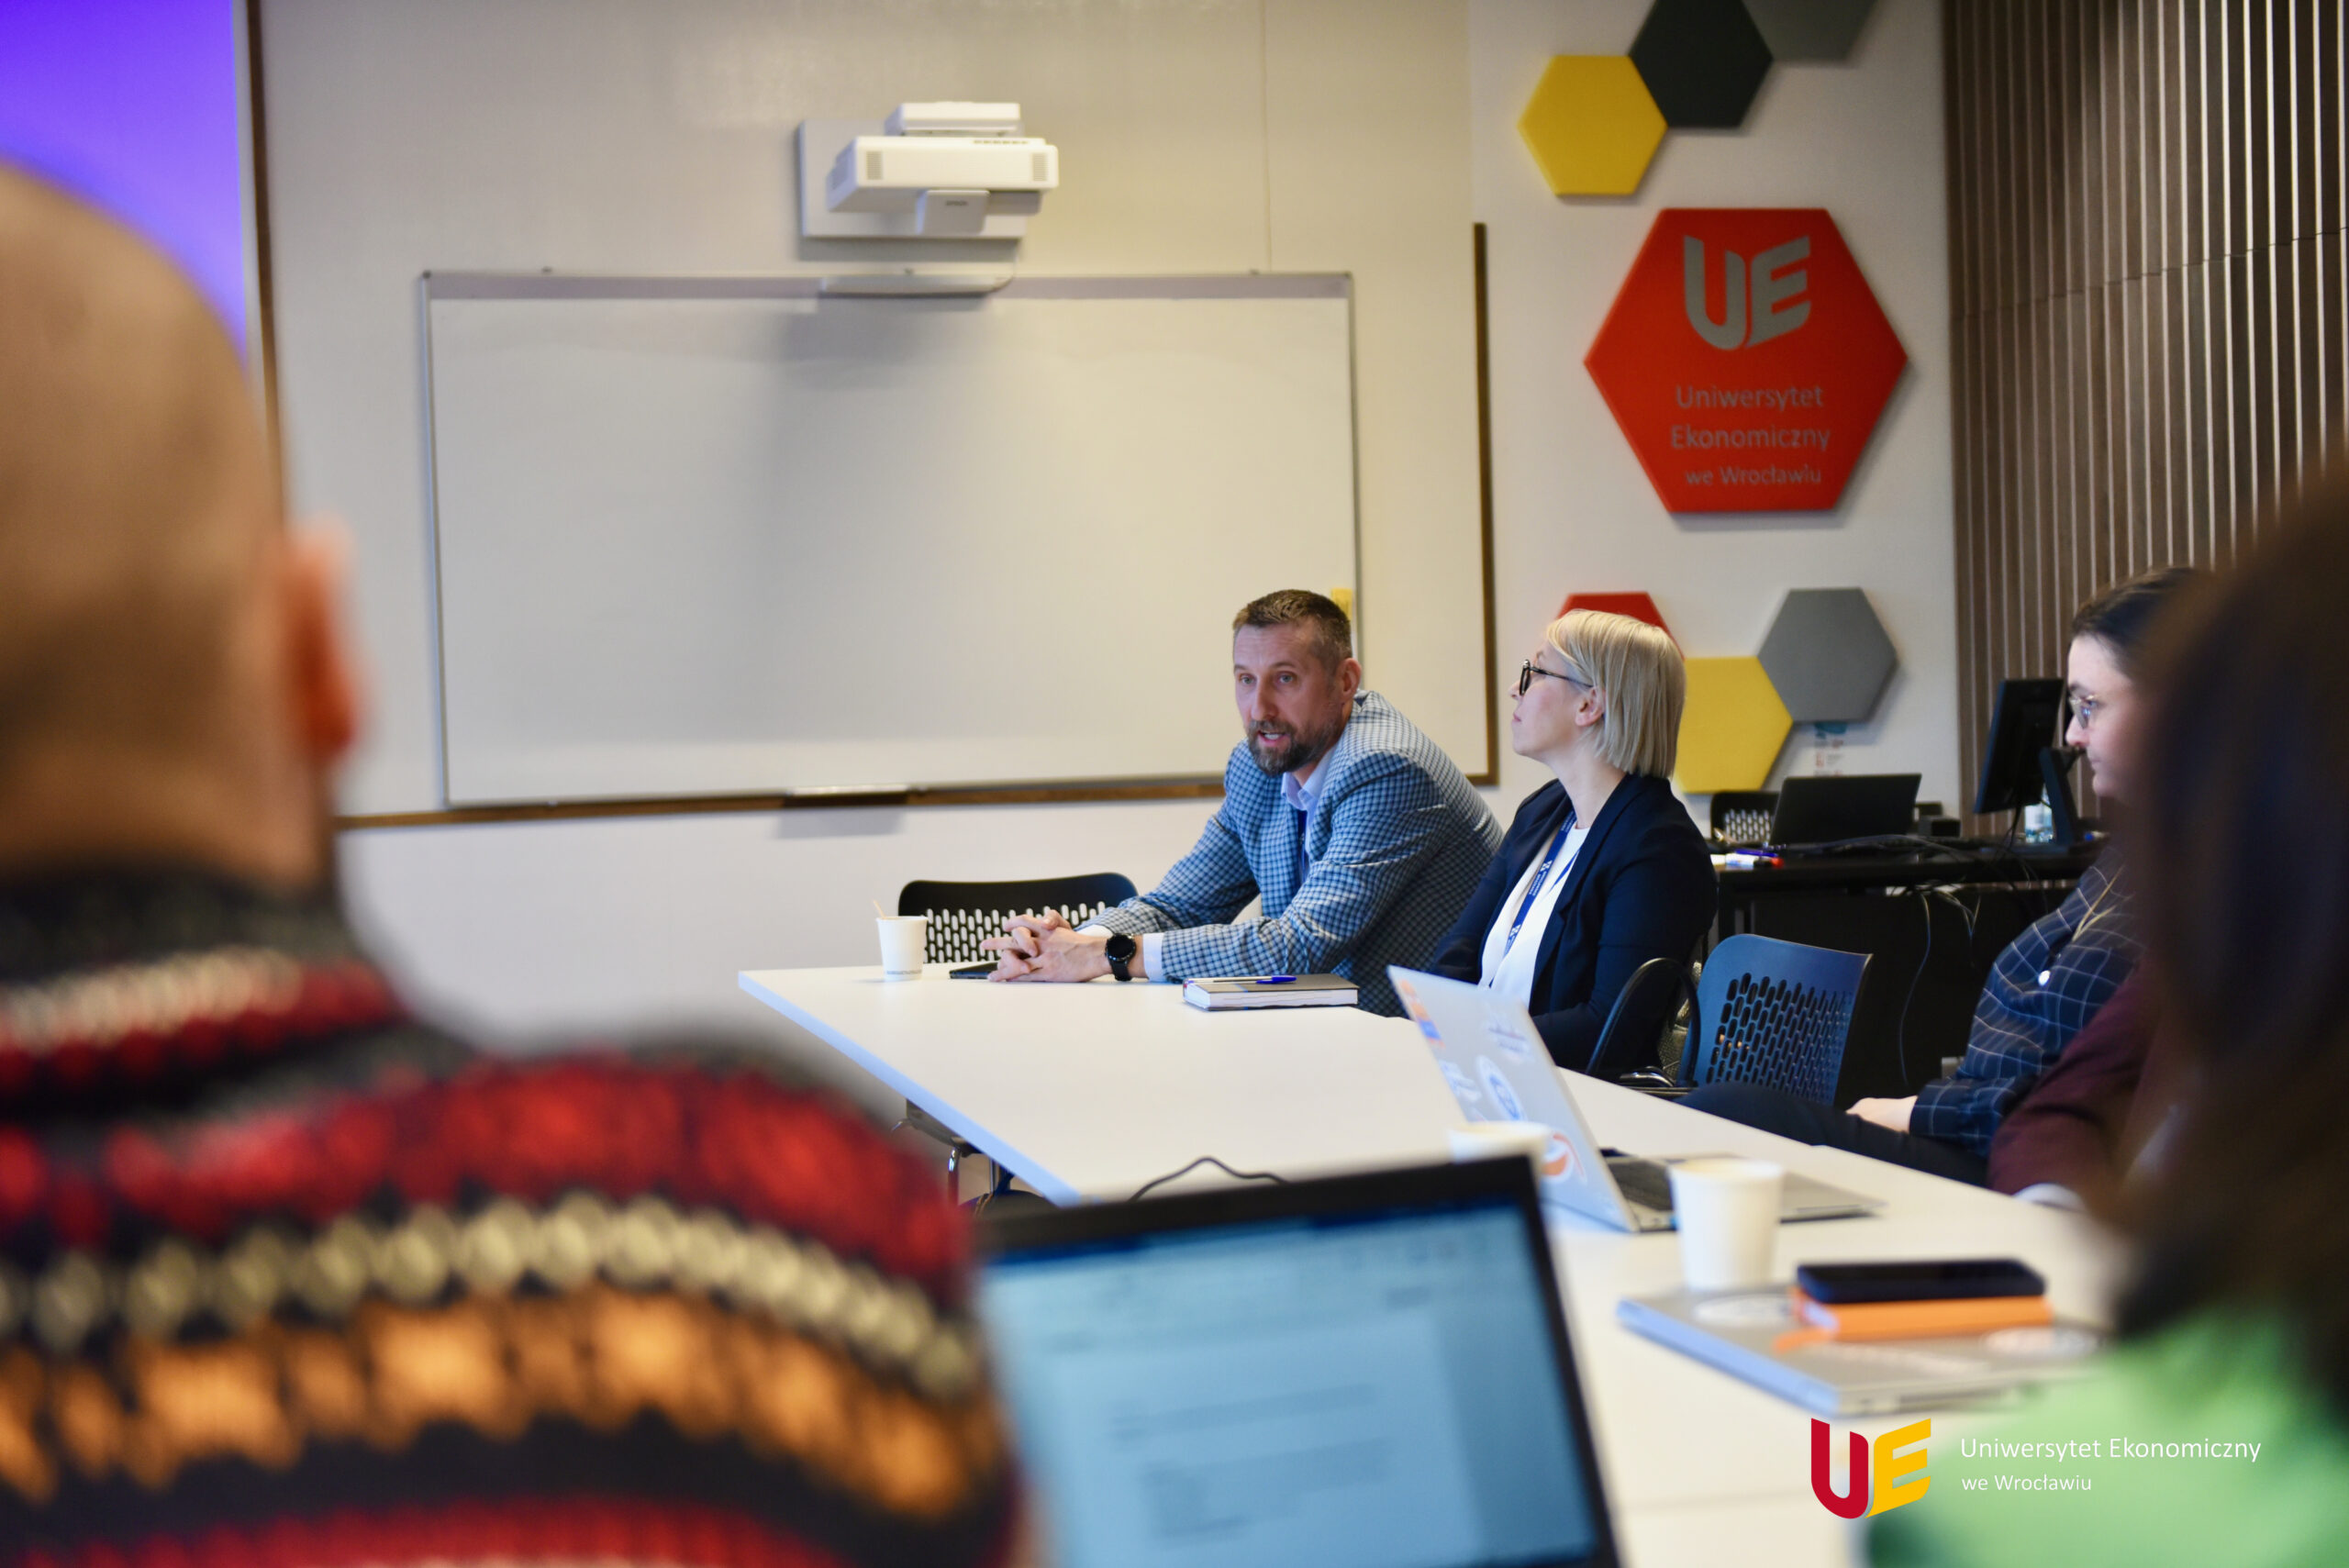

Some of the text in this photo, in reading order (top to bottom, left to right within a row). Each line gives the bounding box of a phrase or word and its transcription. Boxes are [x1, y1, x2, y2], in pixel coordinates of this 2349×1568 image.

[1684, 235, 1811, 350] UE
[1675, 385, 1824, 412] Uniwersytet
[1670, 425, 1831, 451] Ekonomiczny
[1685, 465, 1821, 485] we Wrocławiu
